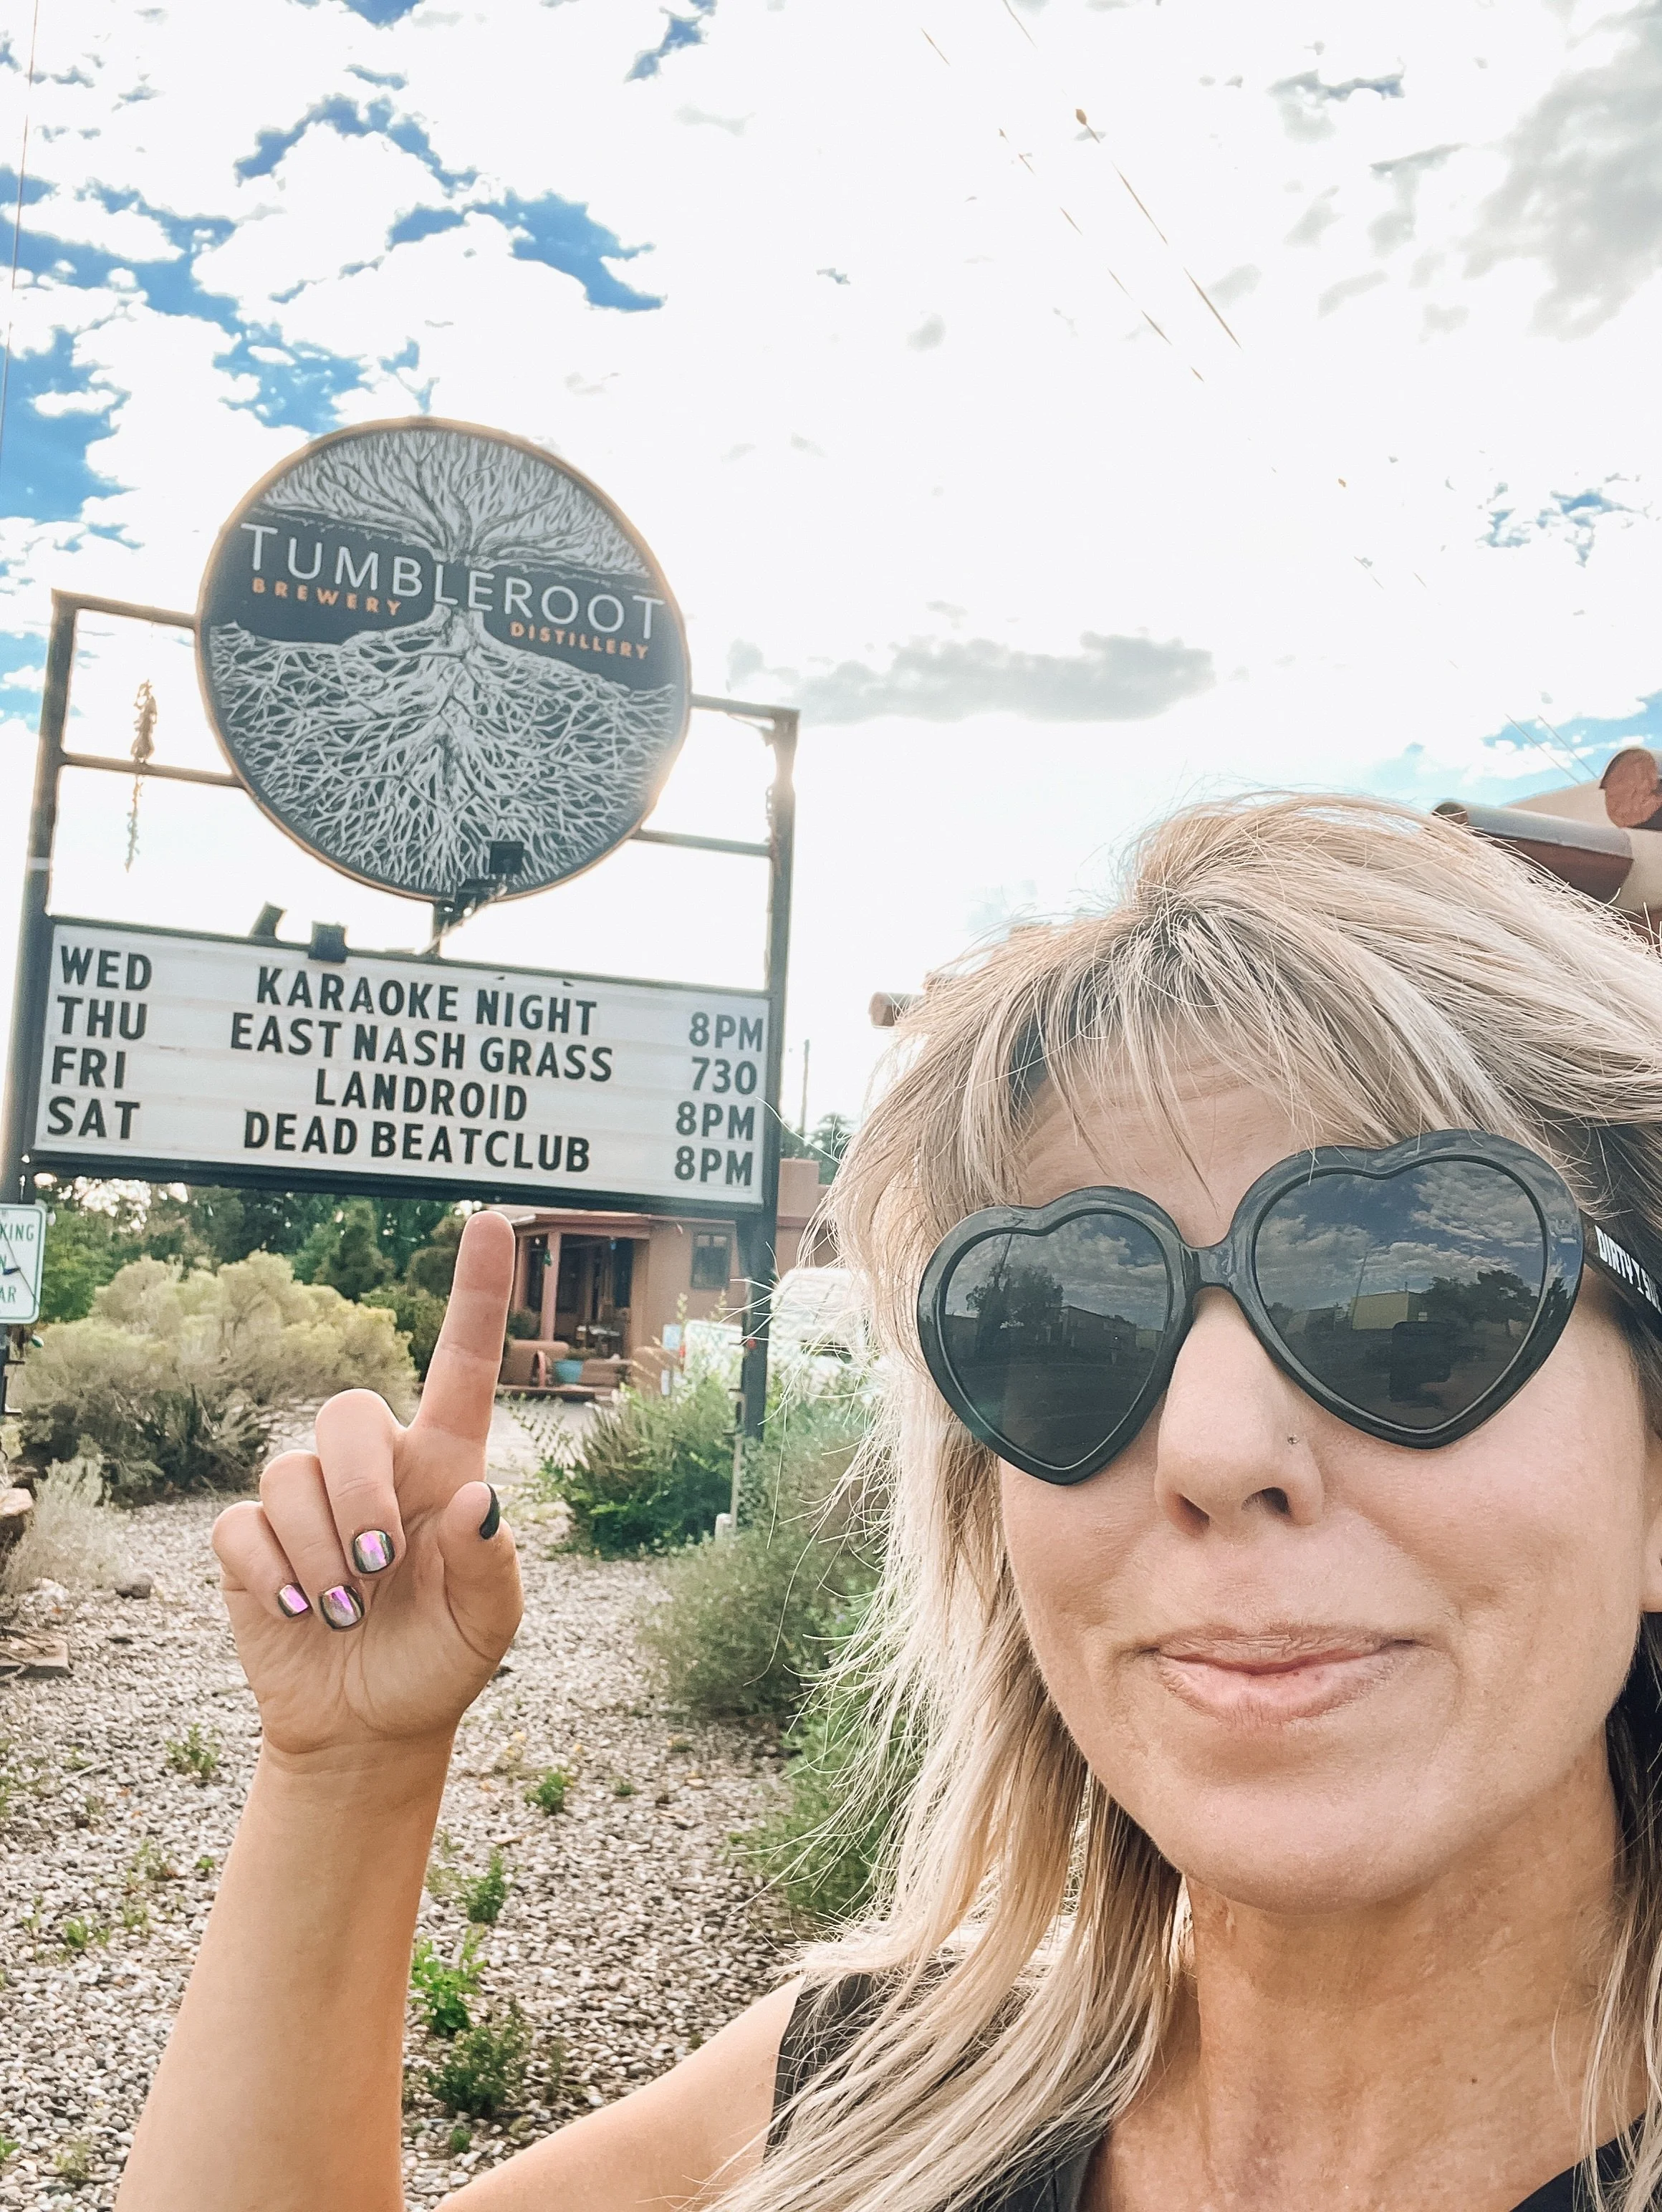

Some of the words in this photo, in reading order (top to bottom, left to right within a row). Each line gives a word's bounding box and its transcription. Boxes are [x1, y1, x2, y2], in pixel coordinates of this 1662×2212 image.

[241, 522, 664, 640] TUMBLEROOT
[251, 577, 401, 616] BREWERY
[509, 620, 648, 660] DISTILLERY
[57, 995, 147, 1041] THU
[231, 1012, 342, 1058] EAST
[353, 1024, 465, 1069] NASH
[480, 1037, 612, 1082] GRASS
[692, 1057, 757, 1095] 730
[61, 946, 151, 991] WED
[257, 966, 459, 1021] KARAOKE
[476, 989, 597, 1036] NIGHT
[689, 1012, 764, 1052] 8PM
[52, 1046, 125, 1089] FRI
[315, 1069, 527, 1121] LANDROID
[676, 1101, 755, 1141] 8PM
[47, 1096, 140, 1140] SAT
[244, 1110, 357, 1155] DEAD
[675, 1145, 753, 1186] 8PM
[1595, 1225, 1634, 1285] DIRTY
